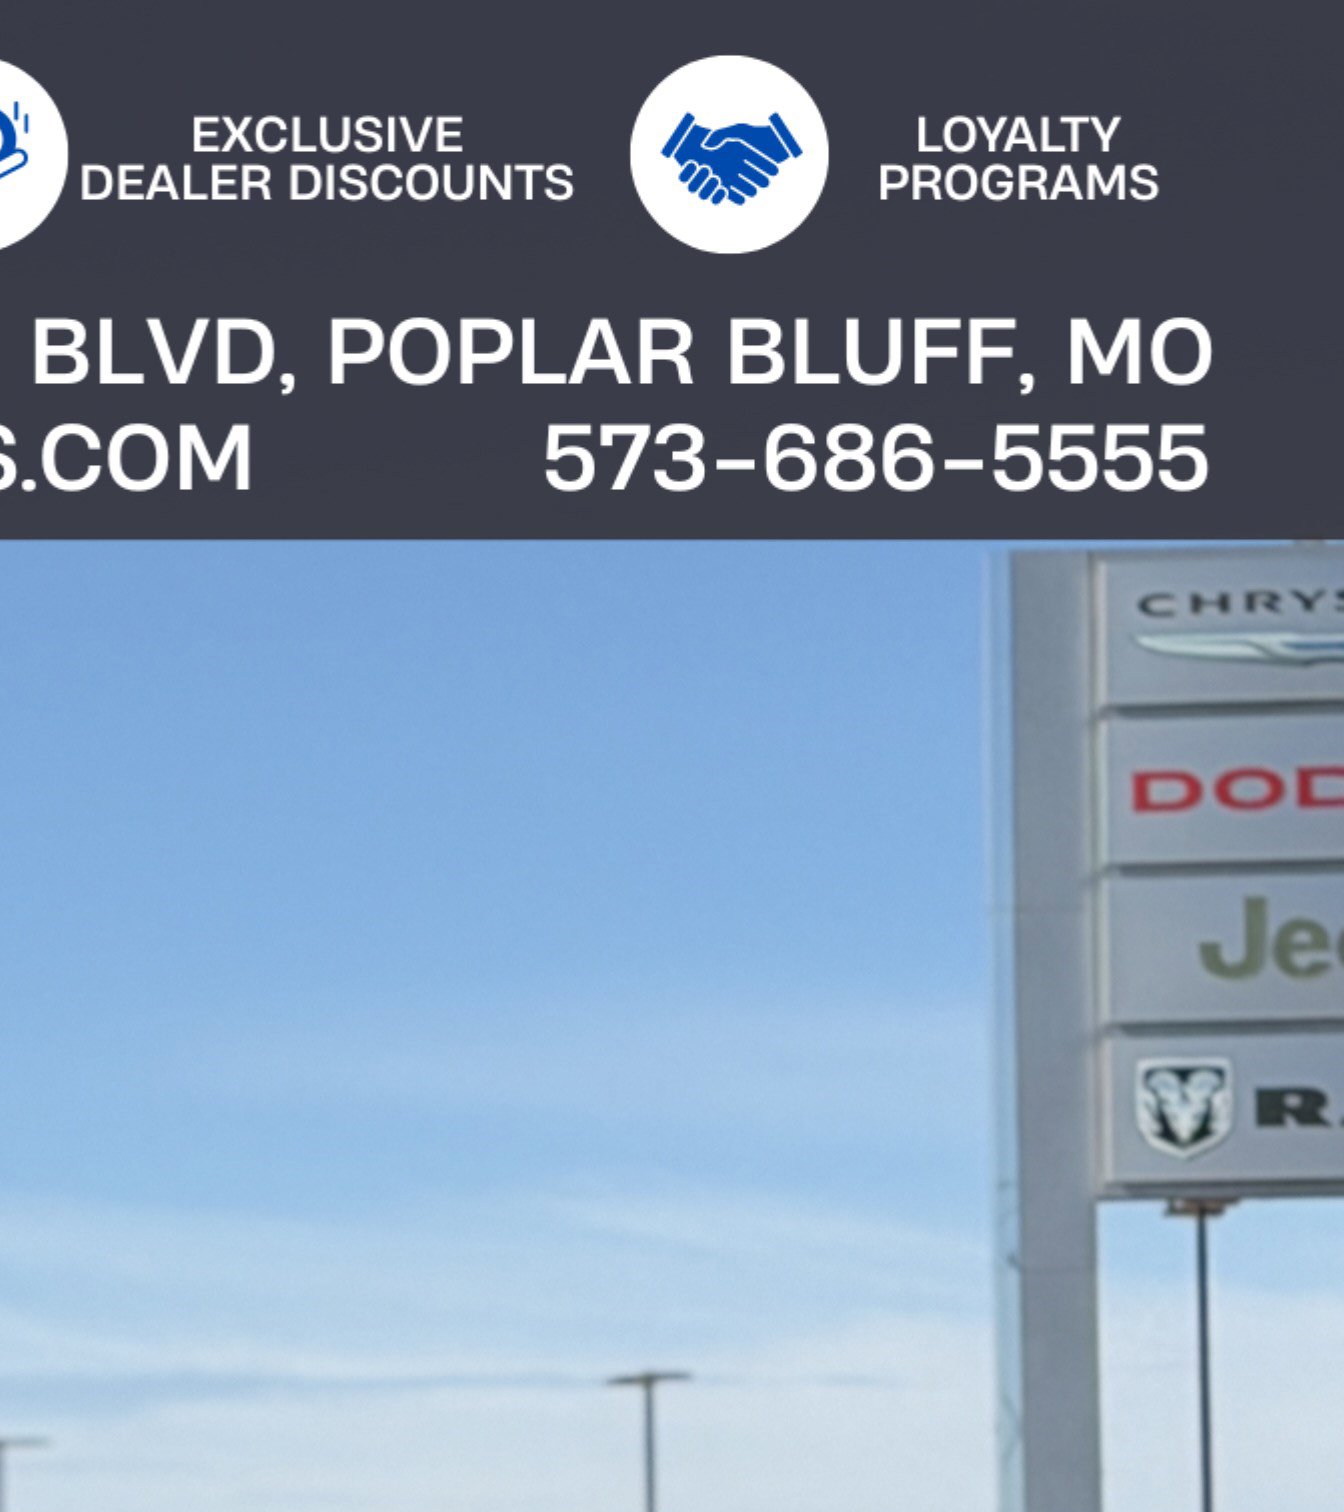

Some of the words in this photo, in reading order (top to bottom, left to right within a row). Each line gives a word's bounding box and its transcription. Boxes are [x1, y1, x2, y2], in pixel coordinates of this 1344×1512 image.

[1137, 589, 1344, 618] CHRY
[1199, 895, 1344, 980] Je
[1255, 1086, 1344, 1128] R
